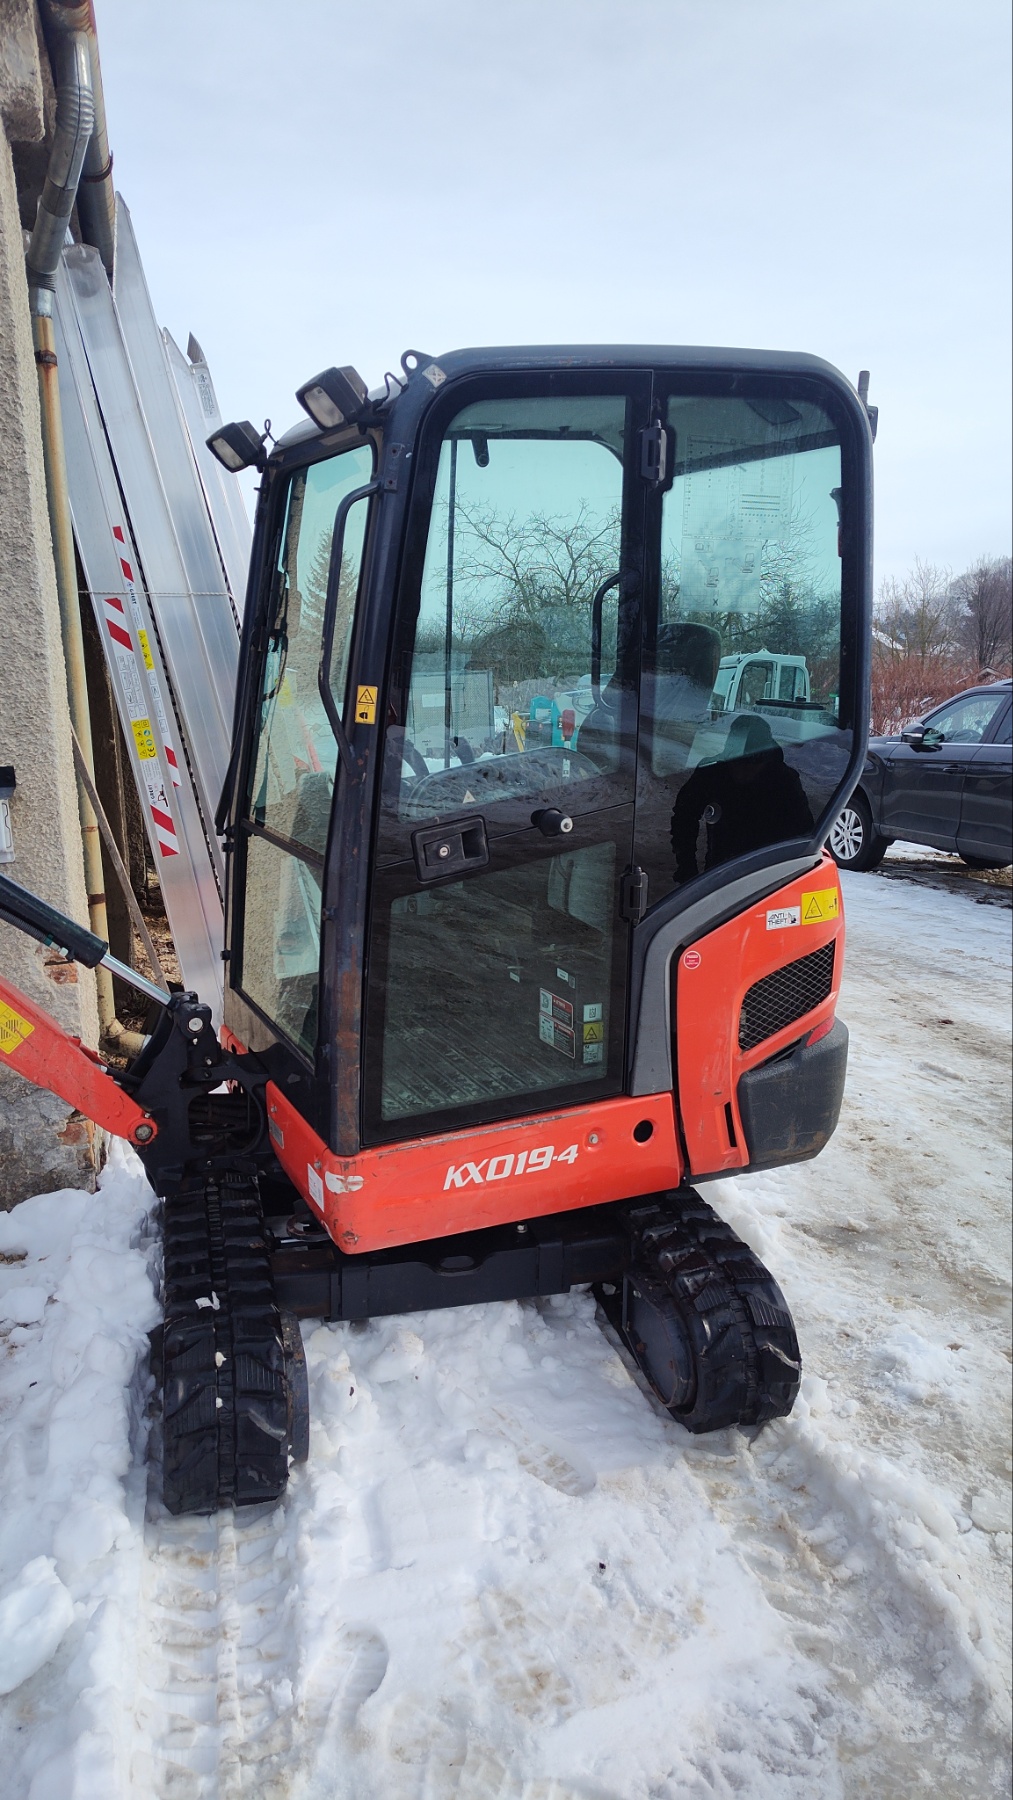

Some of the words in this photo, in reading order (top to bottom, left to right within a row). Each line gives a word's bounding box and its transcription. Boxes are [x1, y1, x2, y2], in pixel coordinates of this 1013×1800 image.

[769, 912, 785, 920] ANTI
[767, 917, 787, 926] THEFT
[443, 1144, 579, 1191] KX019-4
